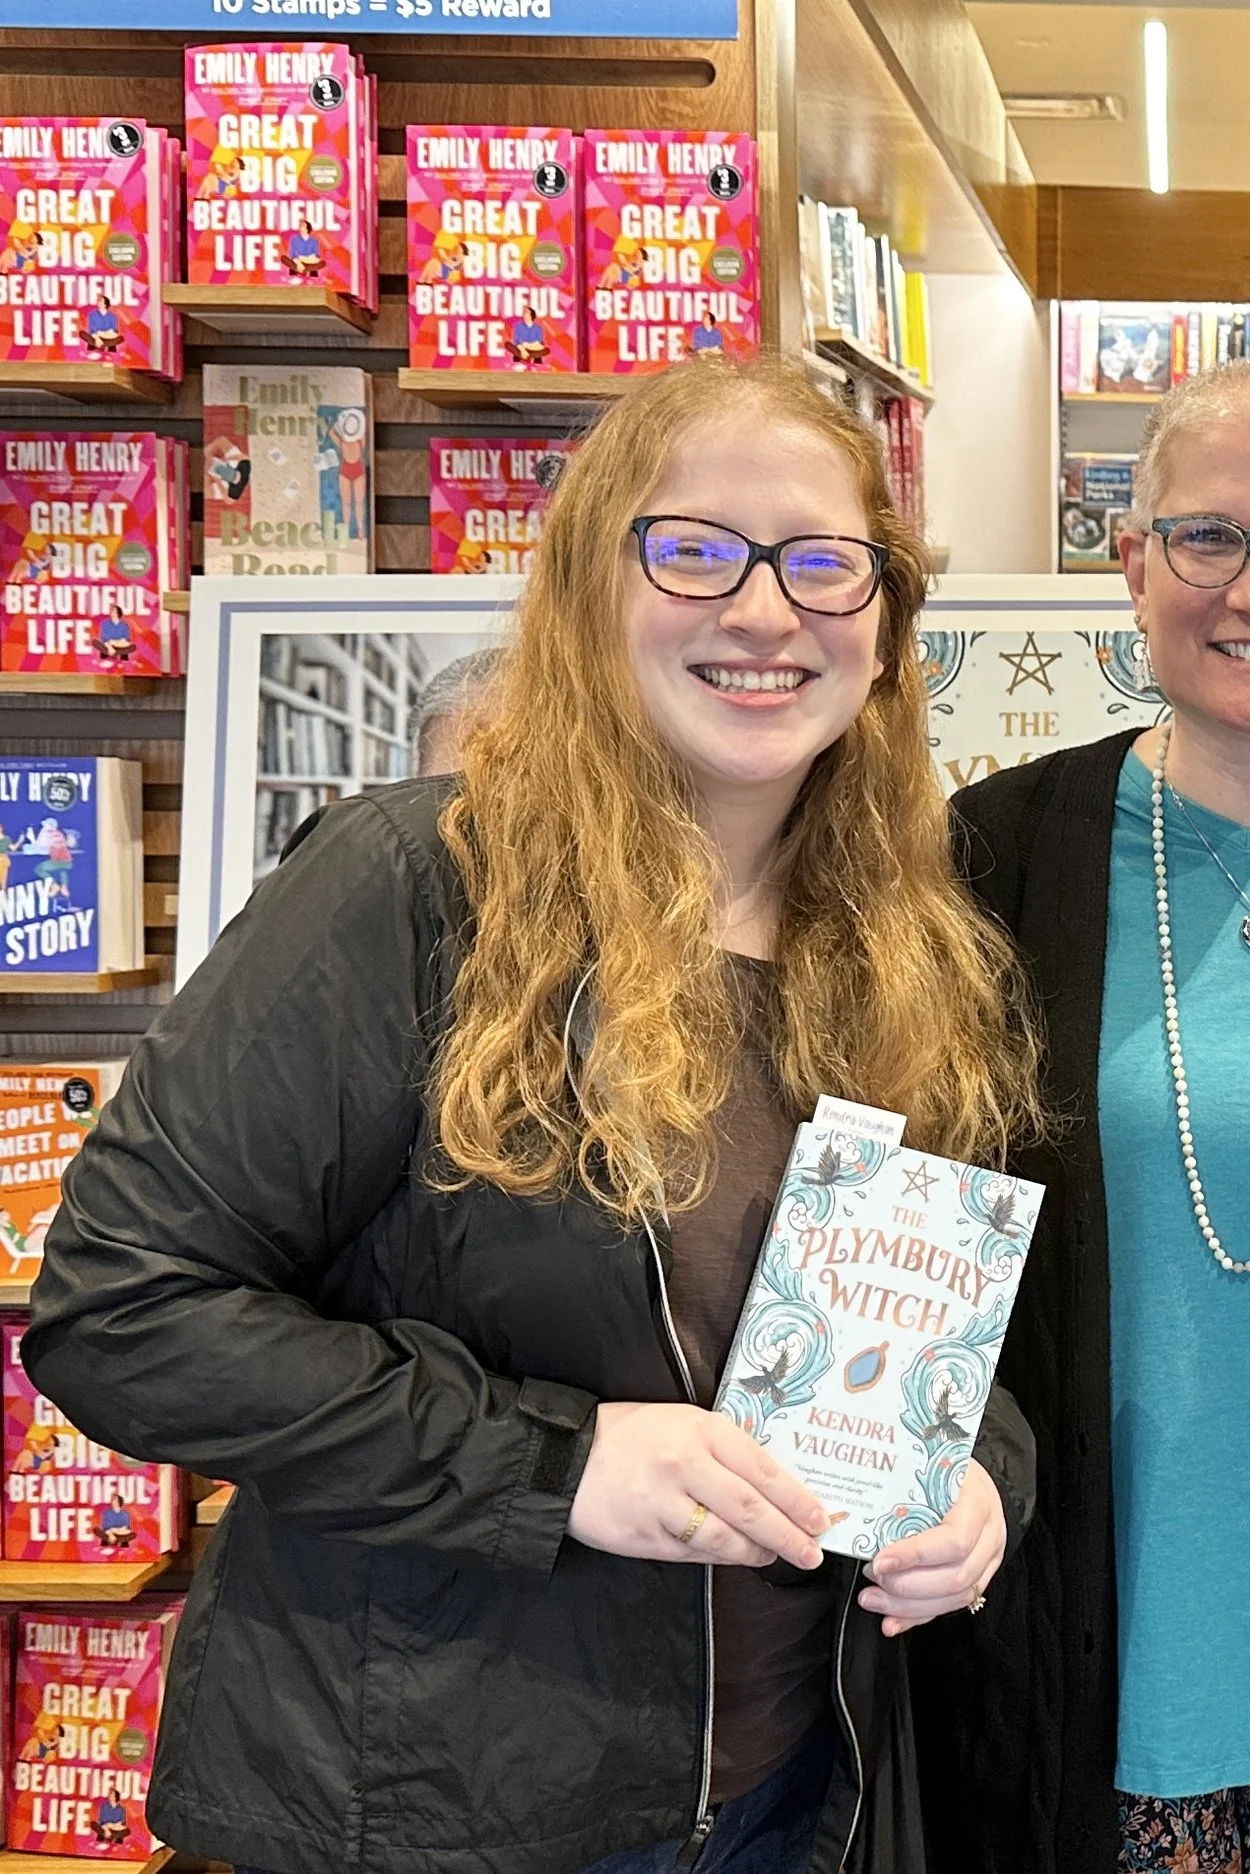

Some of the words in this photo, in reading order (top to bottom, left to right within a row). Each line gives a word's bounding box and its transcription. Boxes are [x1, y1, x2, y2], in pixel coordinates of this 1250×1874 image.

[251, 0, 362, 19] Stamps
[396, 0, 433, 18] $5
[442, 0, 551, 18] Reward
[194, 52, 257, 84] EMILY
[265, 52, 335, 85] HENRY
[218, 113, 318, 150] GREAT
[416, 136, 480, 169] EMILY
[488, 137, 559, 171] HENRY
[595, 142, 659, 175] EMILY
[667, 143, 736, 175] HENRY
[239, 154, 299, 193] BIG
[16, 188, 116, 224] GREAT
[193, 200, 341, 232] BEAUTIFUL
[442, 199, 542, 236] GREAT
[620, 203, 721, 241] GREAT
[38, 230, 96, 268] BIG
[214, 234, 282, 272] LIFE
[463, 240, 523, 280] BIG
[642, 245, 702, 285] BIG
[415, 284, 566, 319] BEAUTIFUL
[594, 290, 744, 324] BEAUTIFUL
[13, 309, 81, 346] LIFE
[437, 319, 506, 357] LIFE
[618, 325, 686, 362] LIFE
[238, 374, 327, 412] Emily
[232, 407, 333, 445] Henry
[5, 440, 66, 472] EMILY
[75, 441, 143, 473] HENRY
[440, 448, 502, 480] EMILY
[30, 501, 128, 536] GREAT
[219, 510, 350, 549] Beach
[465, 508, 542, 543] GREA
[51, 541, 109, 579] BIG
[4, 584, 152, 616] BEAUTIFUL
[27, 618, 93, 655] LIFE
[998, 711, 1061, 738] THE
[0, 876, 54, 926] NNY
[5, 908, 95, 966] STORY
[0, 1131, 52, 1157] MEET
[57, 1132, 80, 1149] ON
[891, 1205, 928, 1229] THE
[797, 1225, 993, 1309] PLYMBURY
[818, 1267, 950, 1336] WITCH
[807, 1406, 896, 1444] KENDRA
[55, 1433, 111, 1469] BIG
[793, 1431, 898, 1473] VAUGHAN
[9, 1474, 152, 1505] BEAUTIFUL
[30, 1507, 95, 1542] LIFE
[24, 1621, 81, 1657] EMILY
[86, 1626, 149, 1660] HENRY
[43, 1682, 131, 1721] GREAT
[59, 1723, 111, 1763] BIG
[15, 1762, 147, 1801] BEAUTIFUL
[32, 1797, 93, 1836] LIFE
